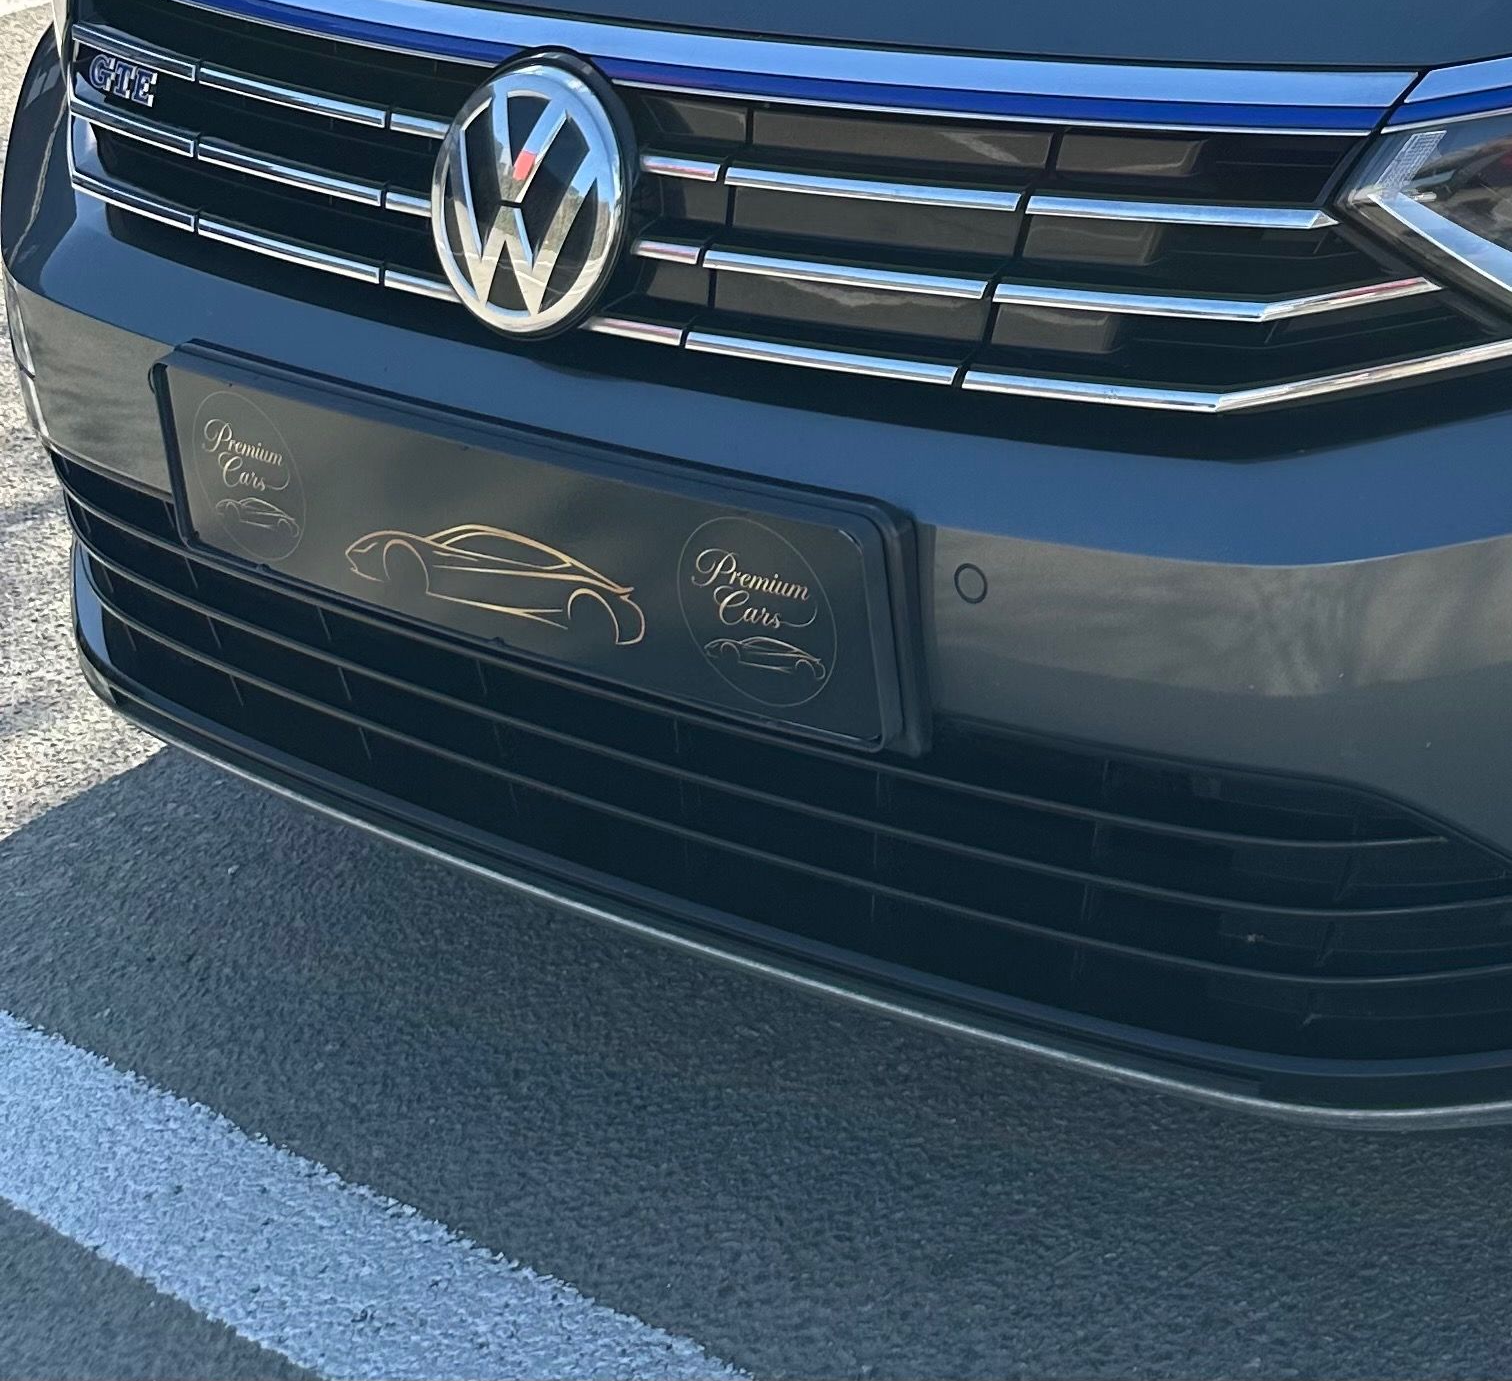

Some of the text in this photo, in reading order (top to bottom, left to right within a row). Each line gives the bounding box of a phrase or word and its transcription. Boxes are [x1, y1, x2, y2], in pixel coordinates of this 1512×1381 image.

[89, 53, 158, 108] GTE
[438, 72, 614, 326] VW
[202, 418, 282, 466] Premium
[218, 451, 290, 491] Cars
[691, 548, 809, 601] Premium
[713, 585, 818, 629] Cars
